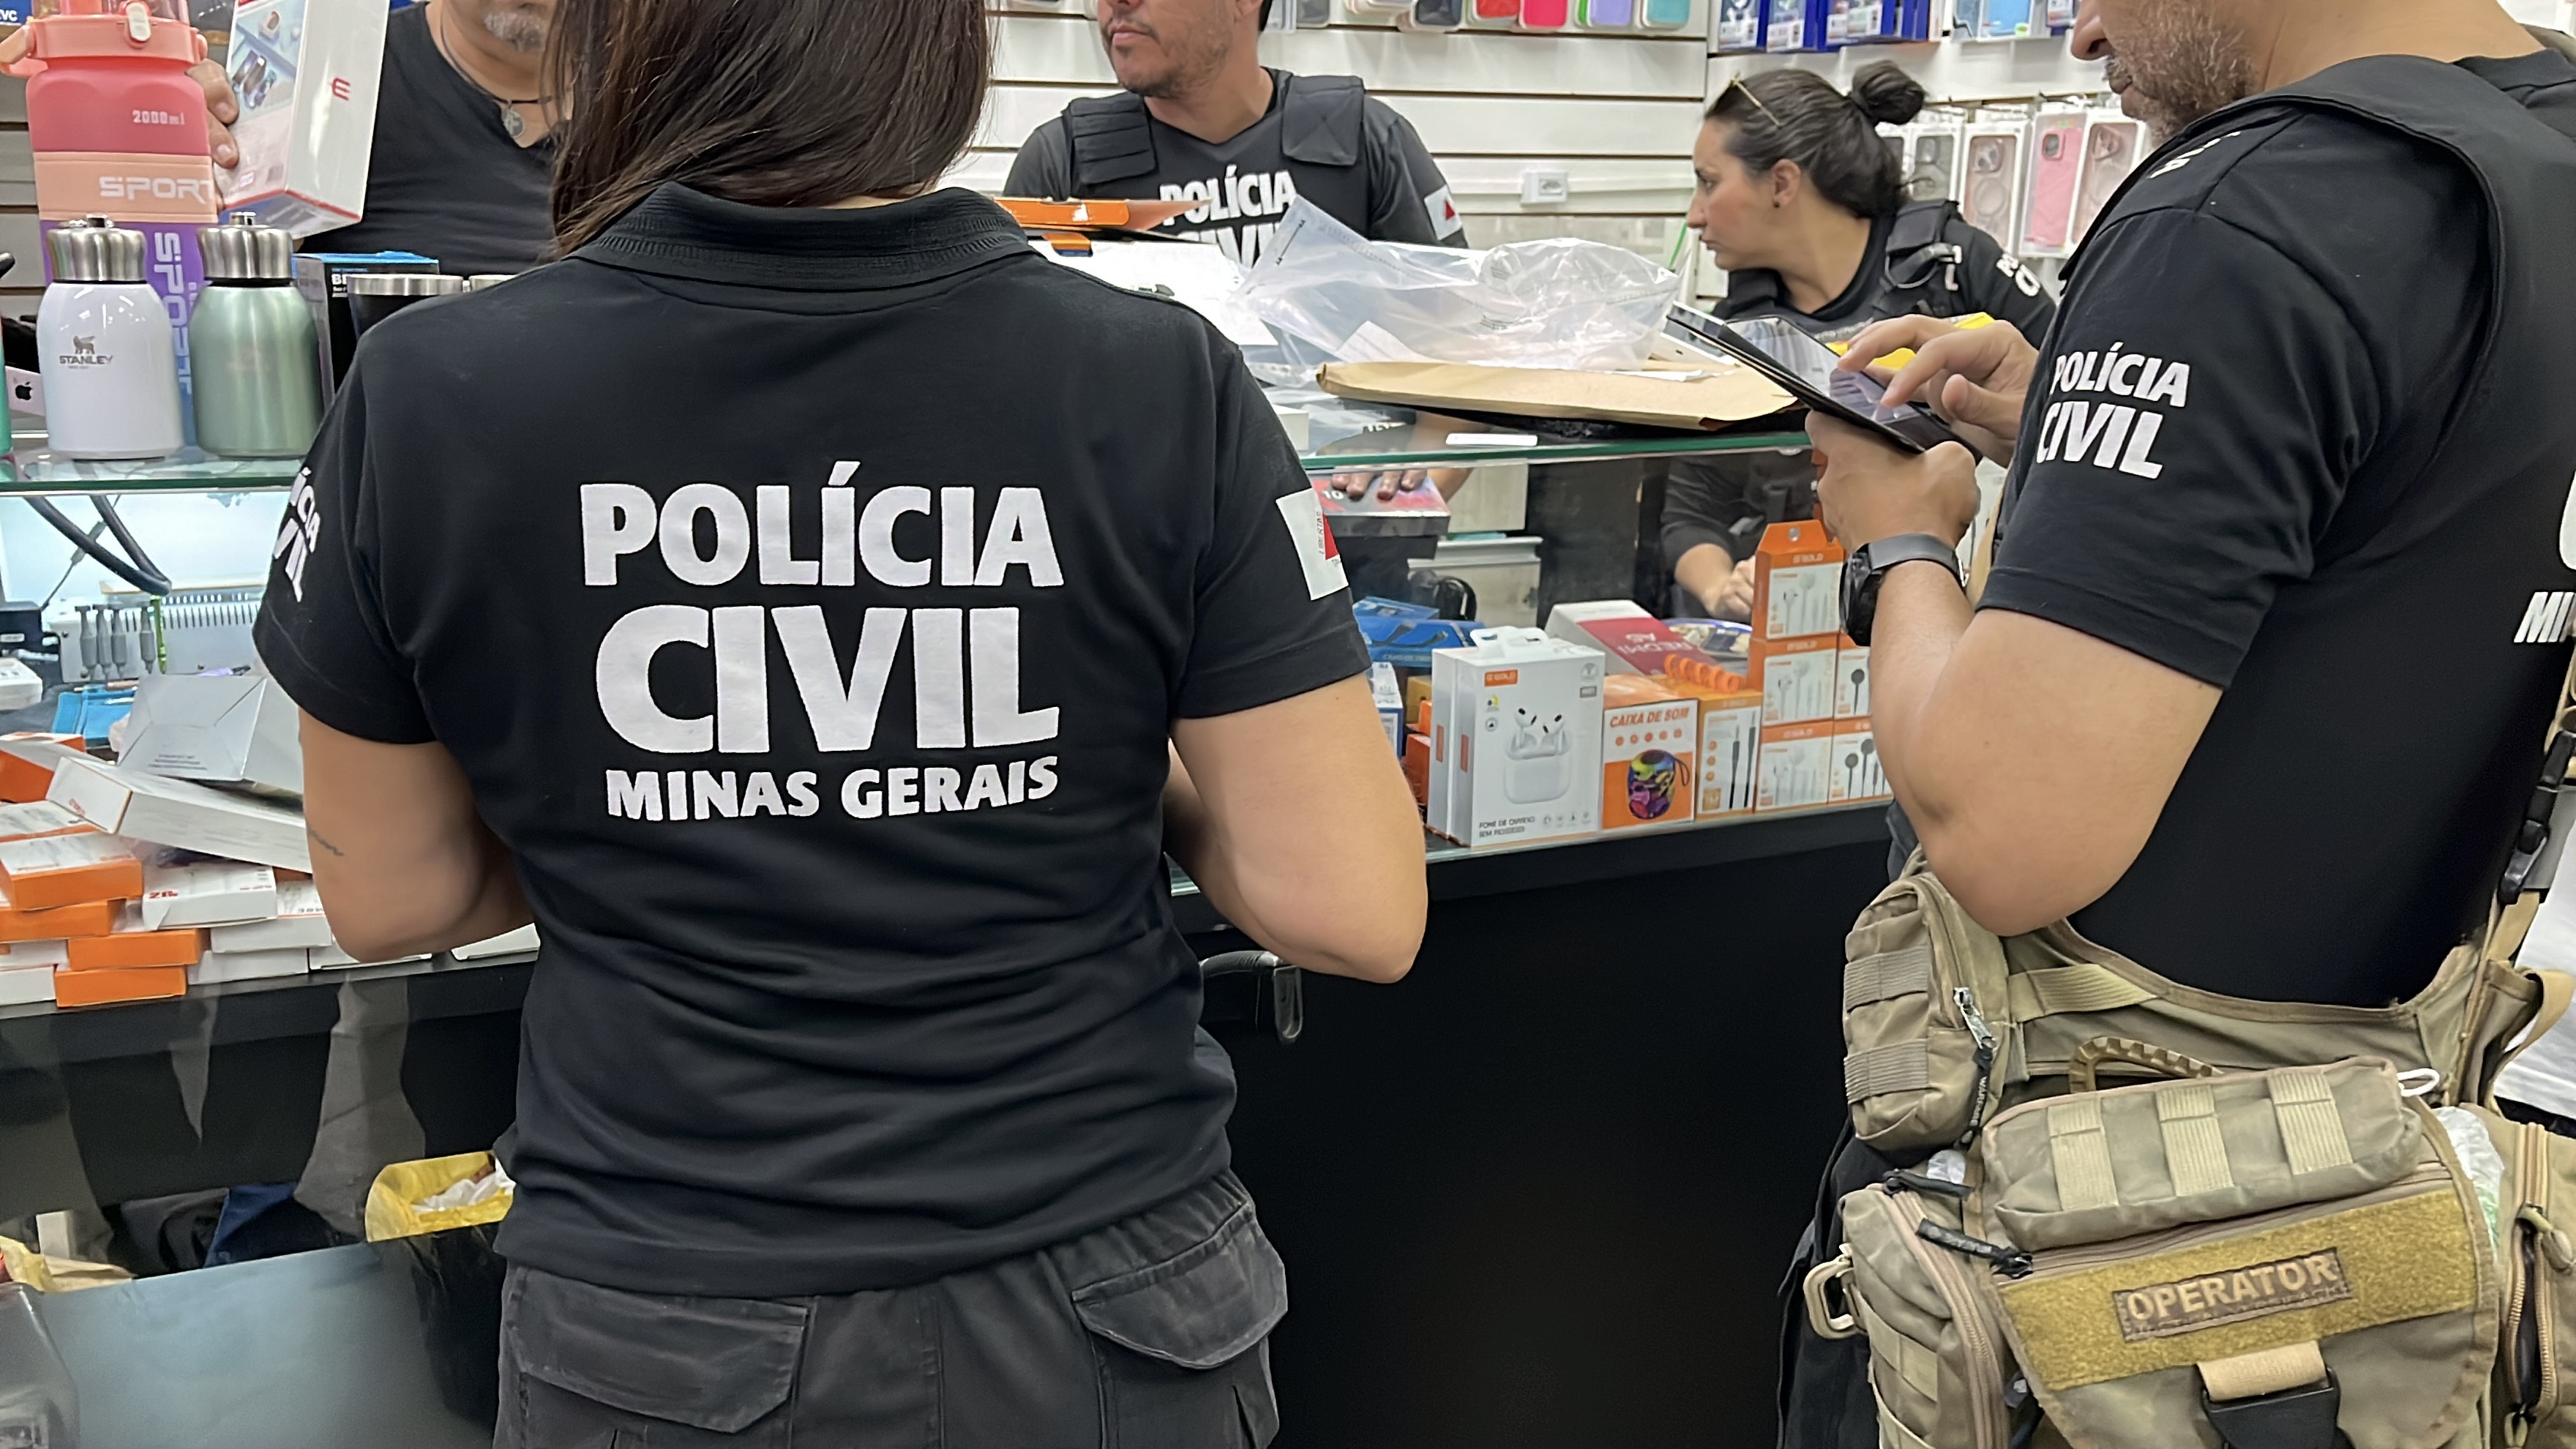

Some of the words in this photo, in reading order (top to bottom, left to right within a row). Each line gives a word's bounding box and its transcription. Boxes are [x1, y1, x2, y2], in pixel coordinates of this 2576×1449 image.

[132, 110, 185, 125] 2000ml
[1160, 164, 1297, 226] POLÍCIA
[59, 356, 113, 364] STANLEY
[2049, 342, 2190, 407] POLÍCIA
[2037, 401, 2163, 479] CIVIL
[580, 460, 1064, 587] POLÍCIA
[596, 604, 1059, 753] CIVIL
[1610, 713, 1644, 728] CAIXA
[1647, 711, 1663, 723] DE
[1664, 708, 1690, 722] SOM
[605, 769, 820, 821] MINAS
[841, 755, 1058, 819] GERAIS
[2127, 1254, 2338, 1321] OPERATOR
